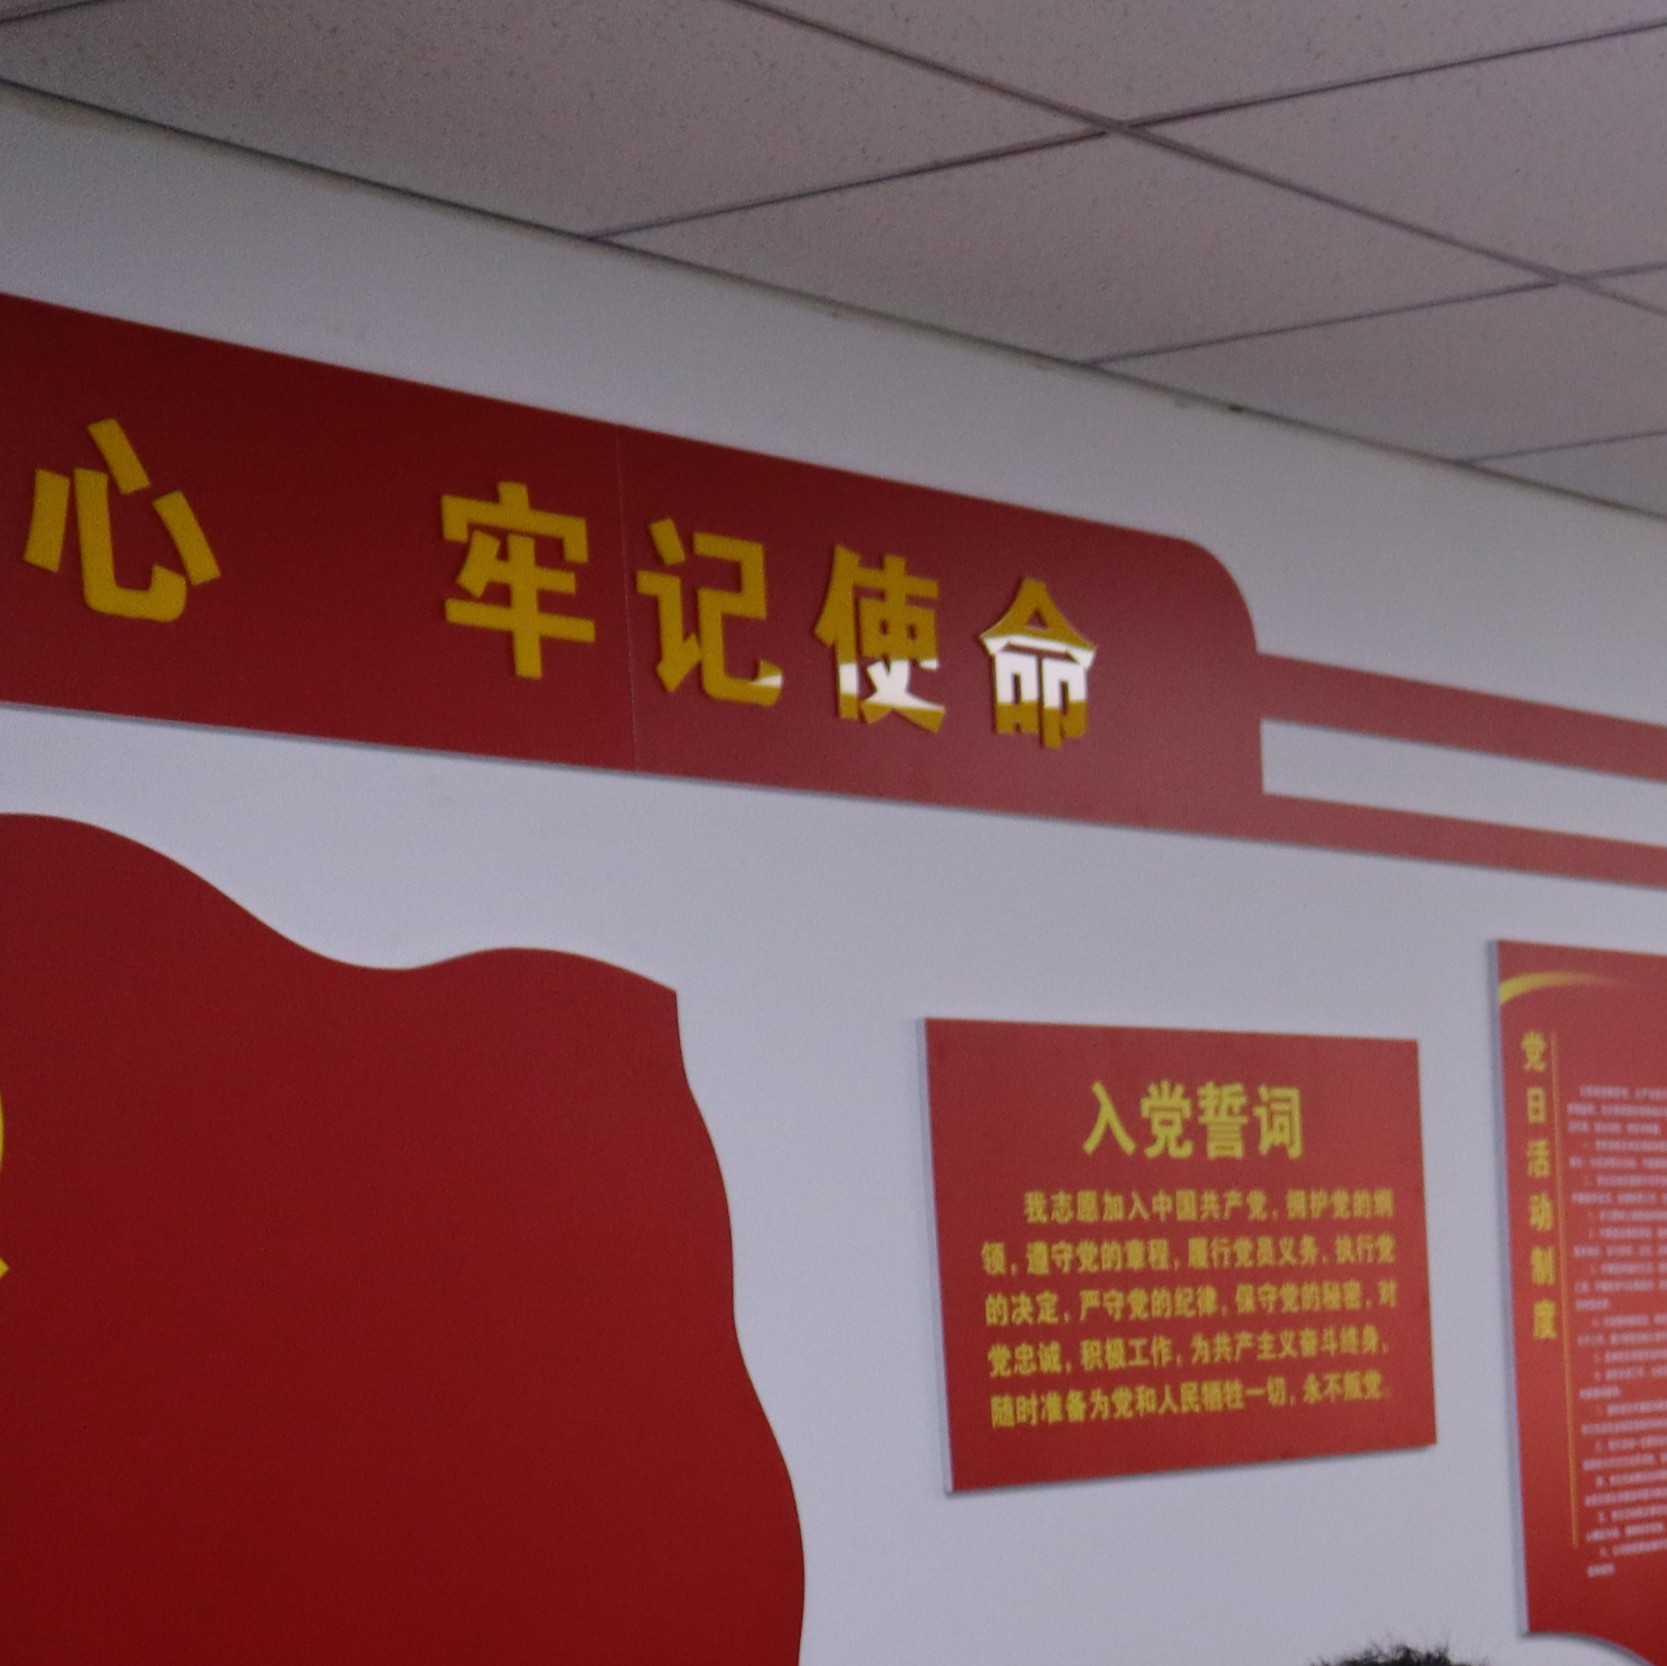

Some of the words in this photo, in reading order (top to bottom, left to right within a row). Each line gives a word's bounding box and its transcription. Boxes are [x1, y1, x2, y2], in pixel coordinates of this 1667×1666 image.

[22, 417, 222, 623] 心
[440, 481, 1098, 749] 牢记使命
[1082, 1080, 1304, 1160] 入党誓词
[1521, 1031, 1557, 1340] 党日活动制度
